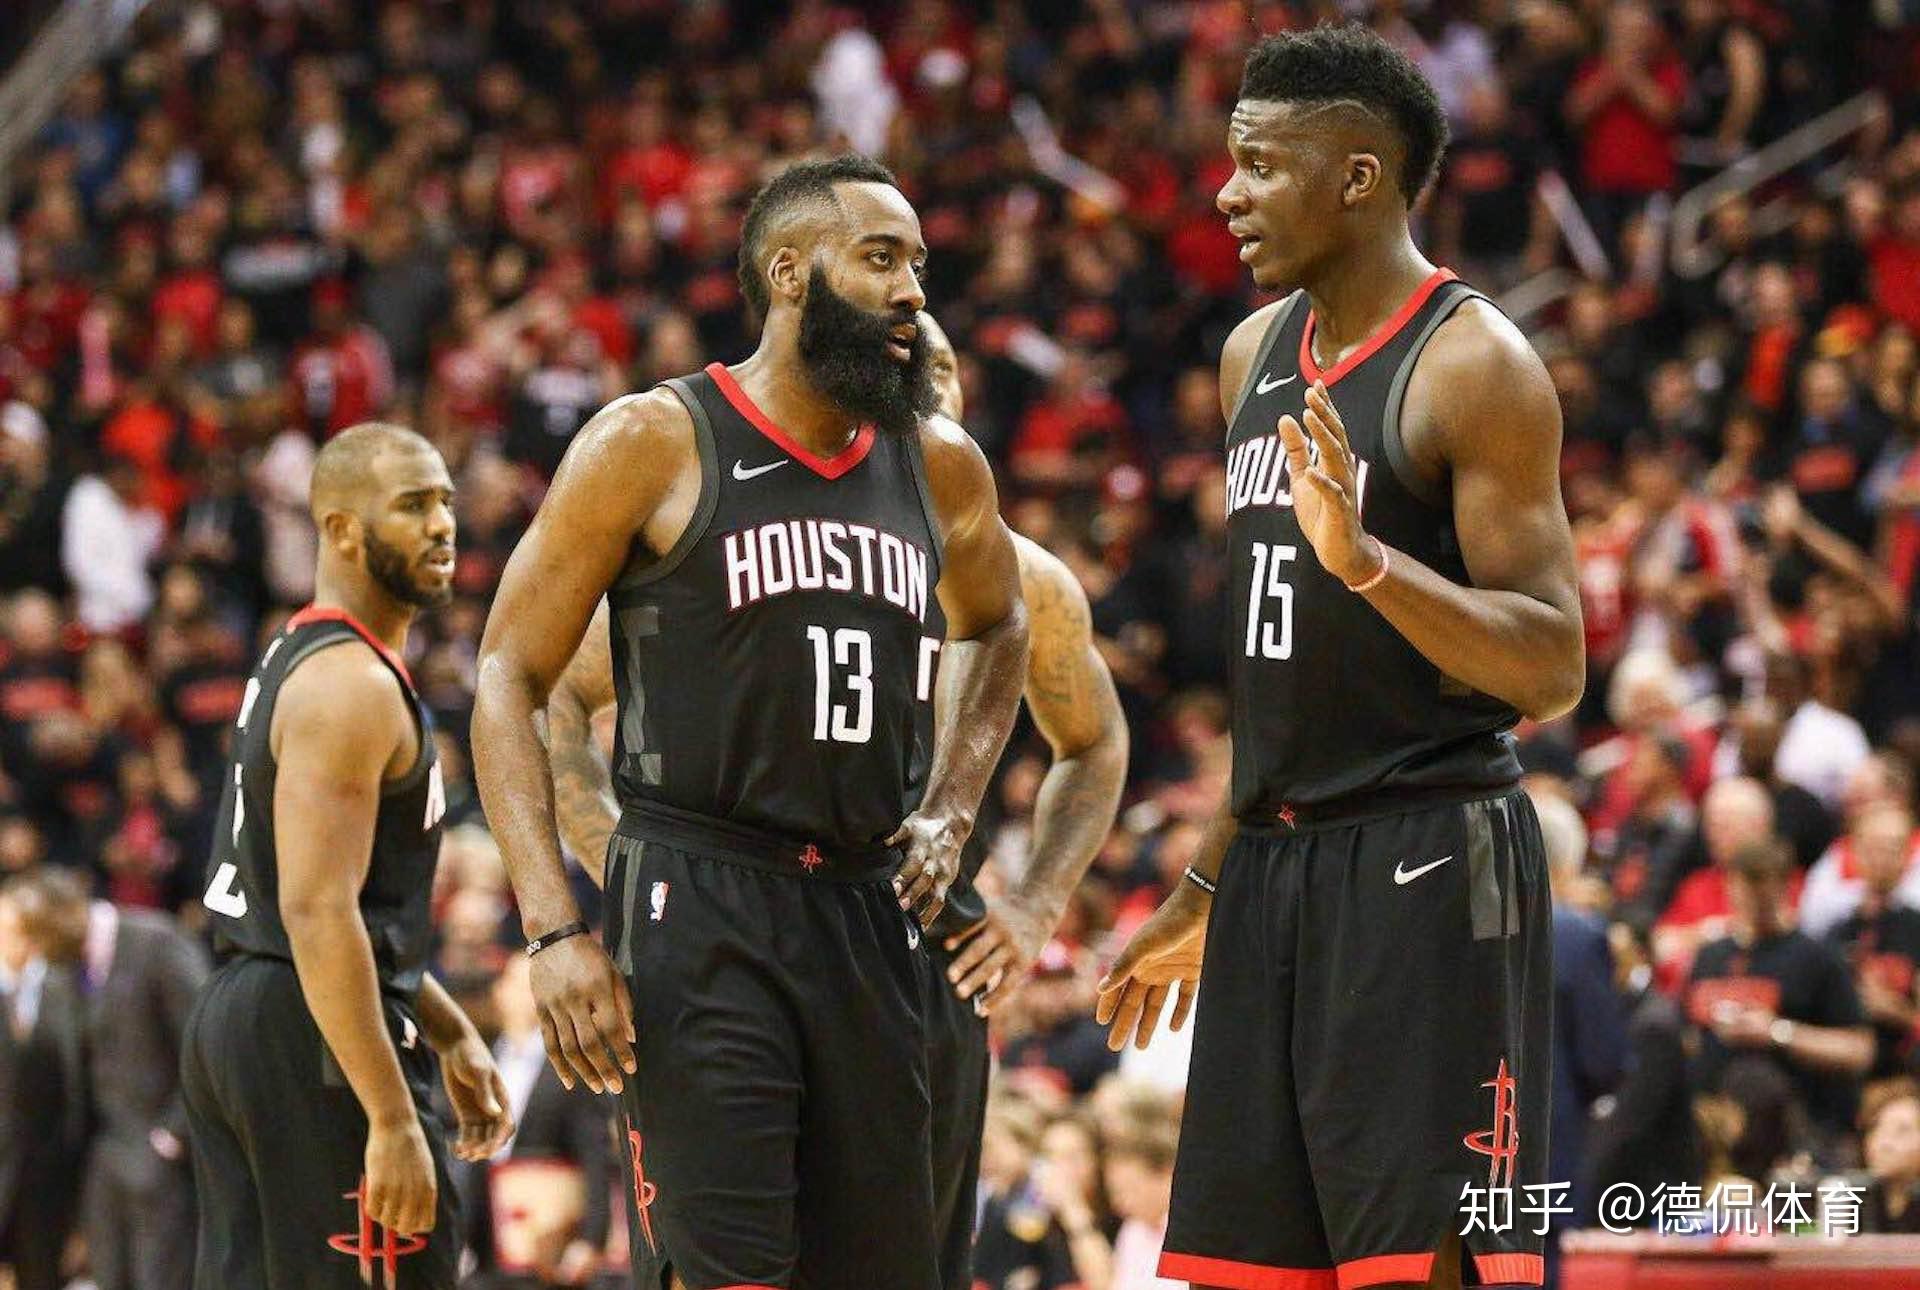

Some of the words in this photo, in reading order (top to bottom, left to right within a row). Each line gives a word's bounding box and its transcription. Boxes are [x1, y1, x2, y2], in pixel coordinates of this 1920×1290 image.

[724, 519, 928, 624] HOUSTON
[1245, 542, 1297, 661] 15
[806, 624, 874, 744] 13
